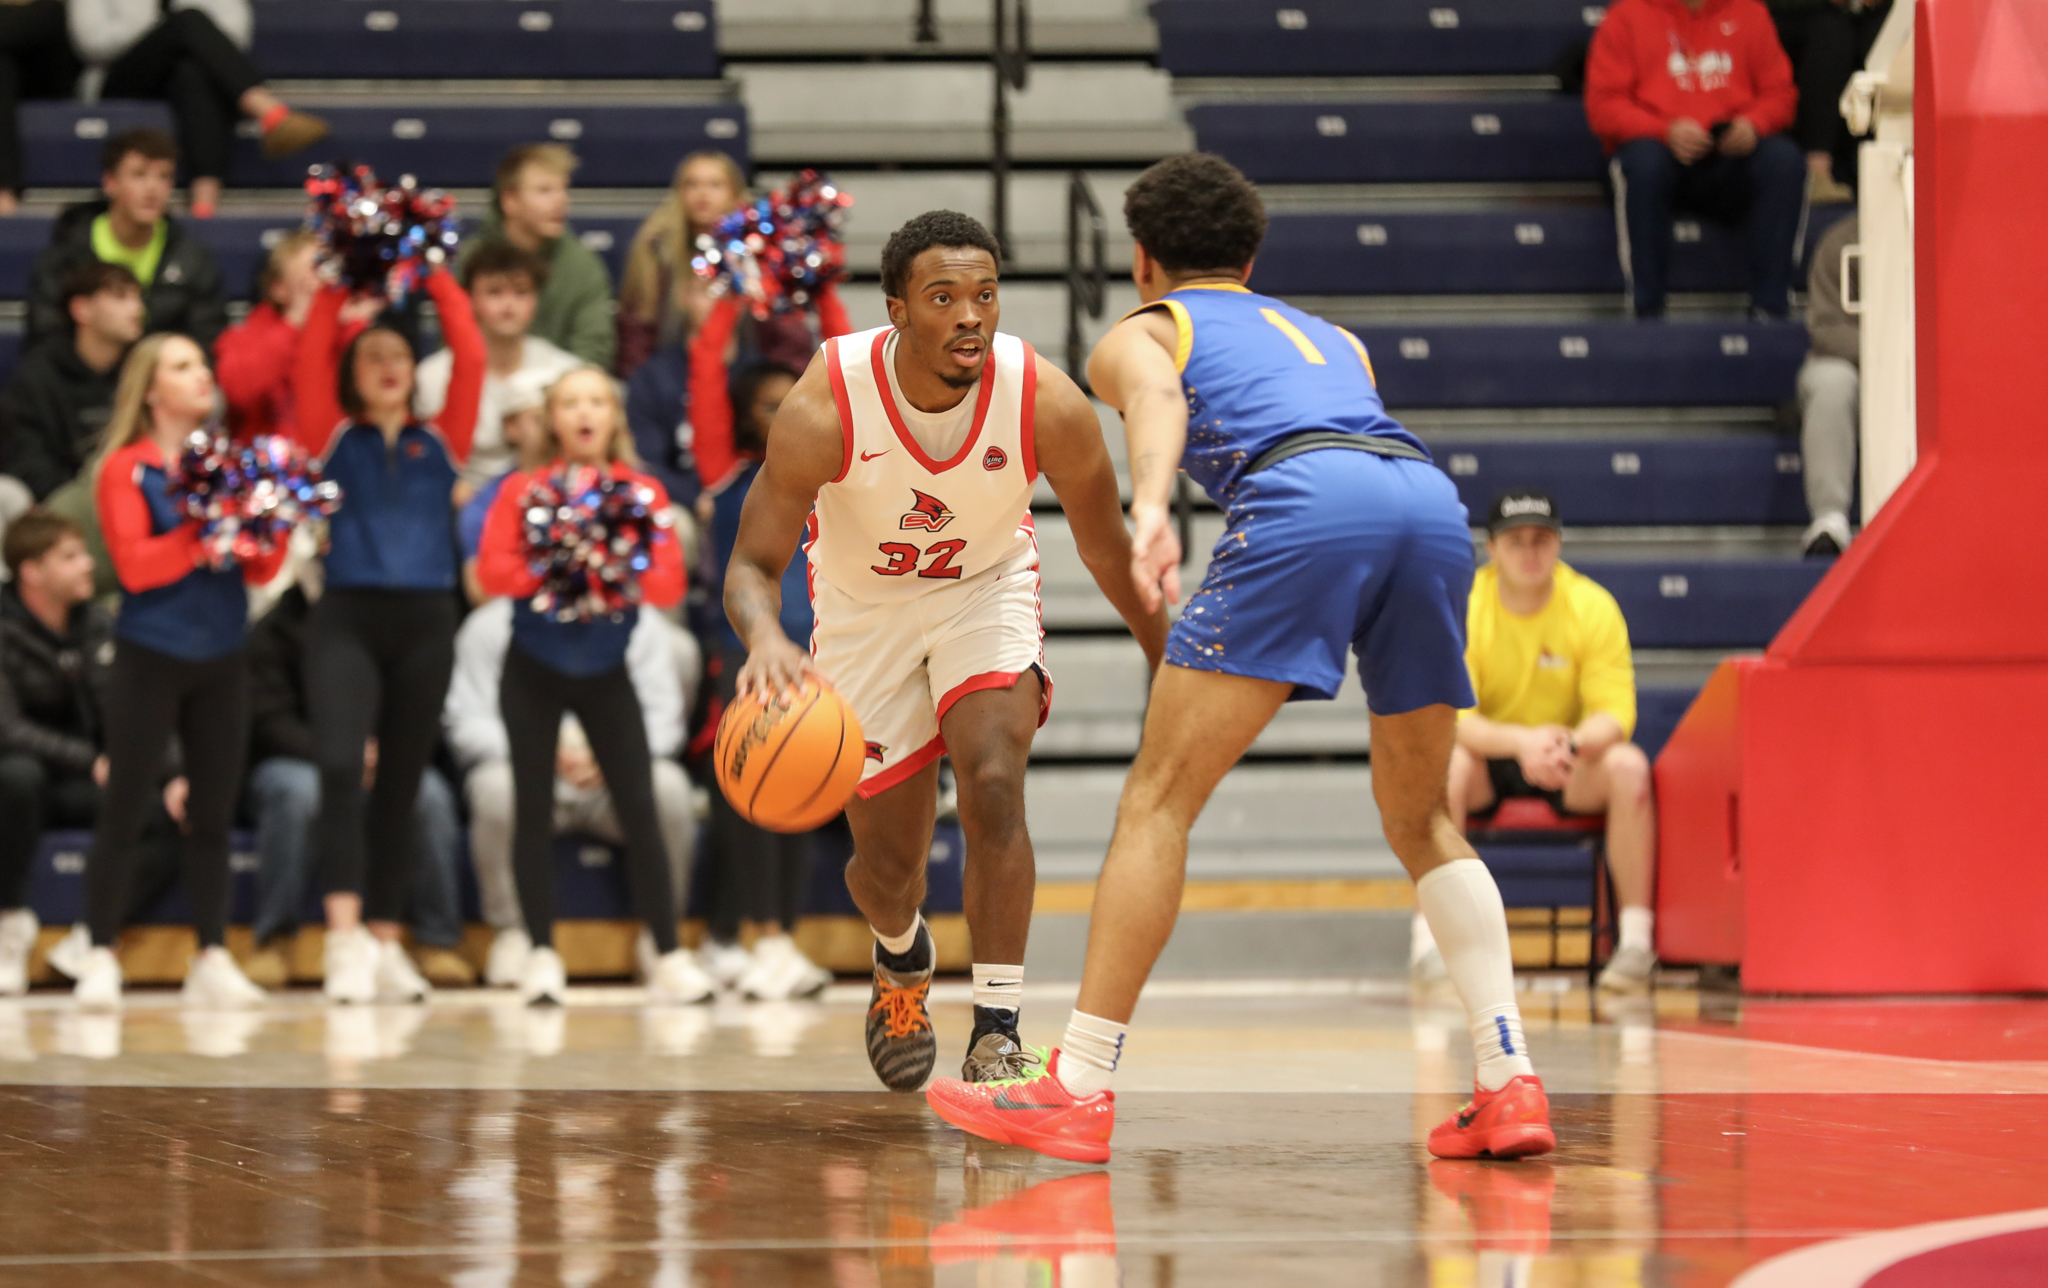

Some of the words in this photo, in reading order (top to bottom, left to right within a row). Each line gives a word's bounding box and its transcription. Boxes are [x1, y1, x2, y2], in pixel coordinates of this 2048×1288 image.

[1259, 308, 1328, 365] 1
[901, 513, 954, 532] SV
[870, 538, 967, 579] 32
